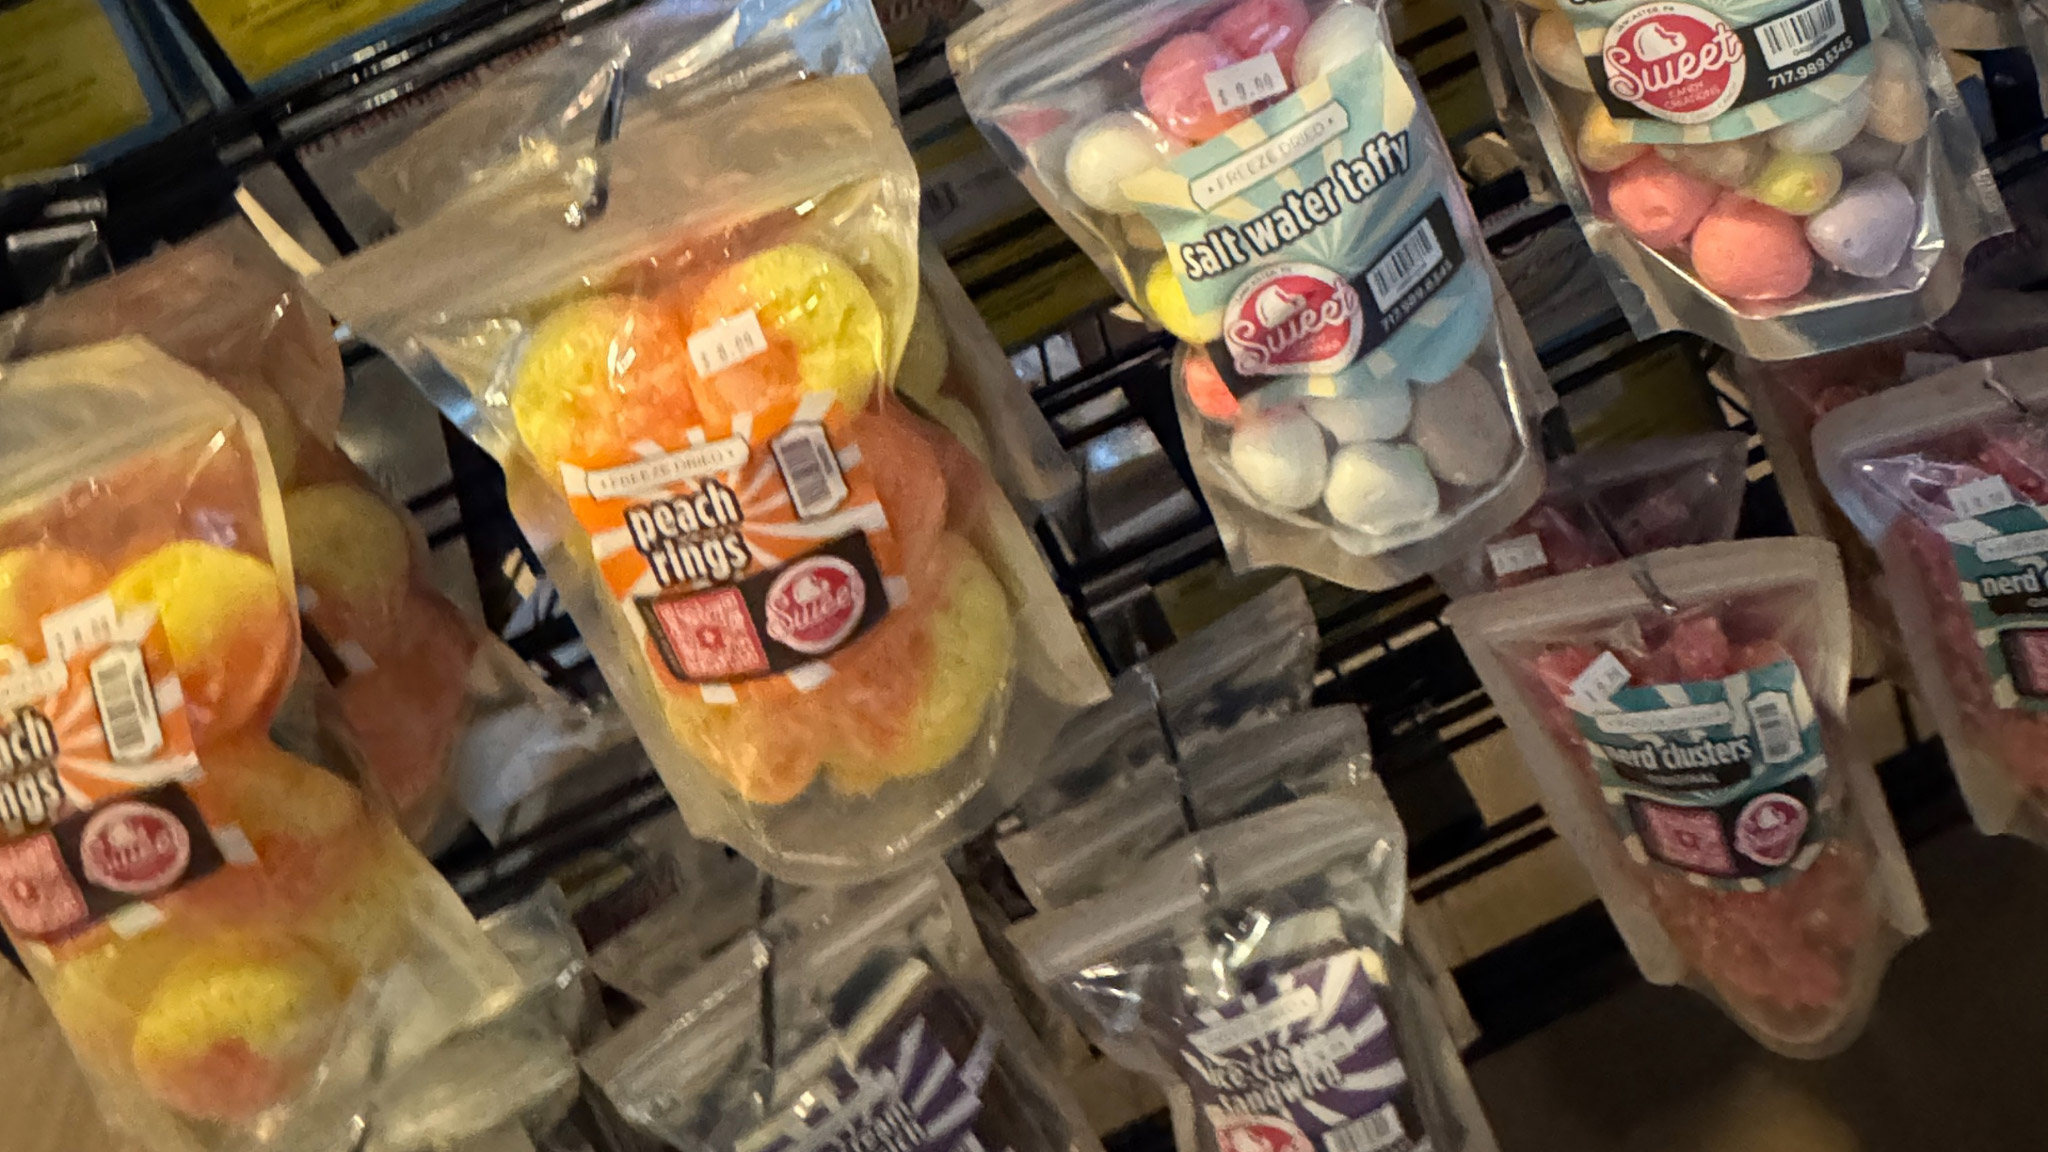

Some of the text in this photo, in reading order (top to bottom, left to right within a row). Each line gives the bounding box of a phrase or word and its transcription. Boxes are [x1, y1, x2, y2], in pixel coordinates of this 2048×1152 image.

[1606, 23, 1742, 101] Sweet
[1767, 35, 1854, 89] 717.989.6345
[1215, 121, 1326, 190] FREEZE DRIED
[1181, 129, 1410, 280] salt water taffy
[1229, 277, 1357, 375] Sweet
[625, 480, 743, 554] peach
[649, 531, 752, 588] rings
[1981, 568, 2041, 597] nerd
[1661, 738, 1753, 770] clusters
